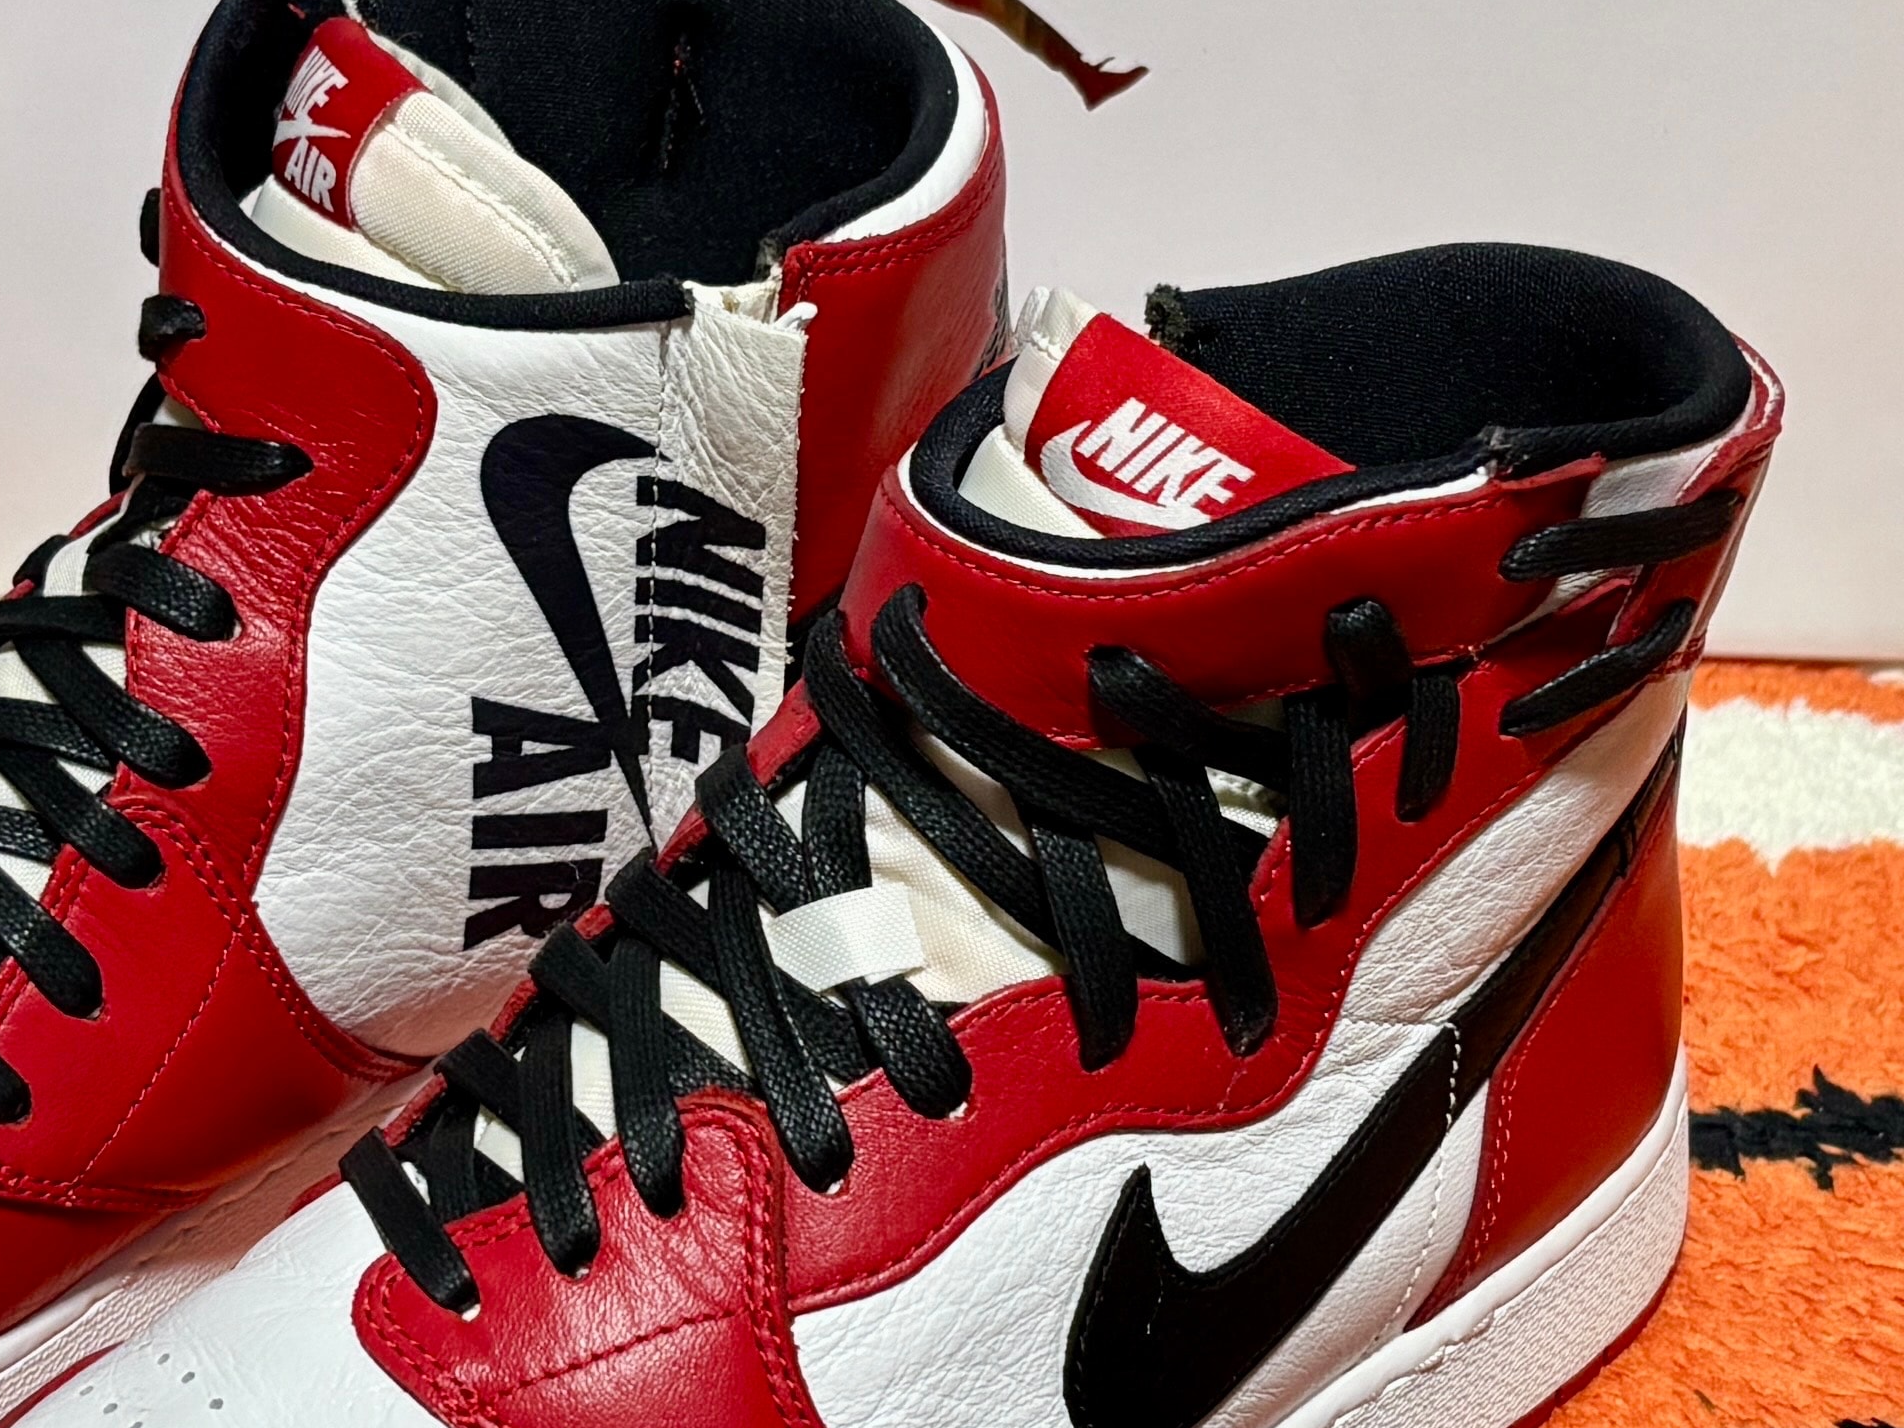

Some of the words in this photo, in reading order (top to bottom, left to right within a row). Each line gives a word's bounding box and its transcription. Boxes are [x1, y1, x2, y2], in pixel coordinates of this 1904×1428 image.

[283, 135, 335, 214] AIR
[1074, 396, 1257, 522] NIKE
[630, 475, 767, 765] NIKE
[462, 695, 613, 951] AIR
